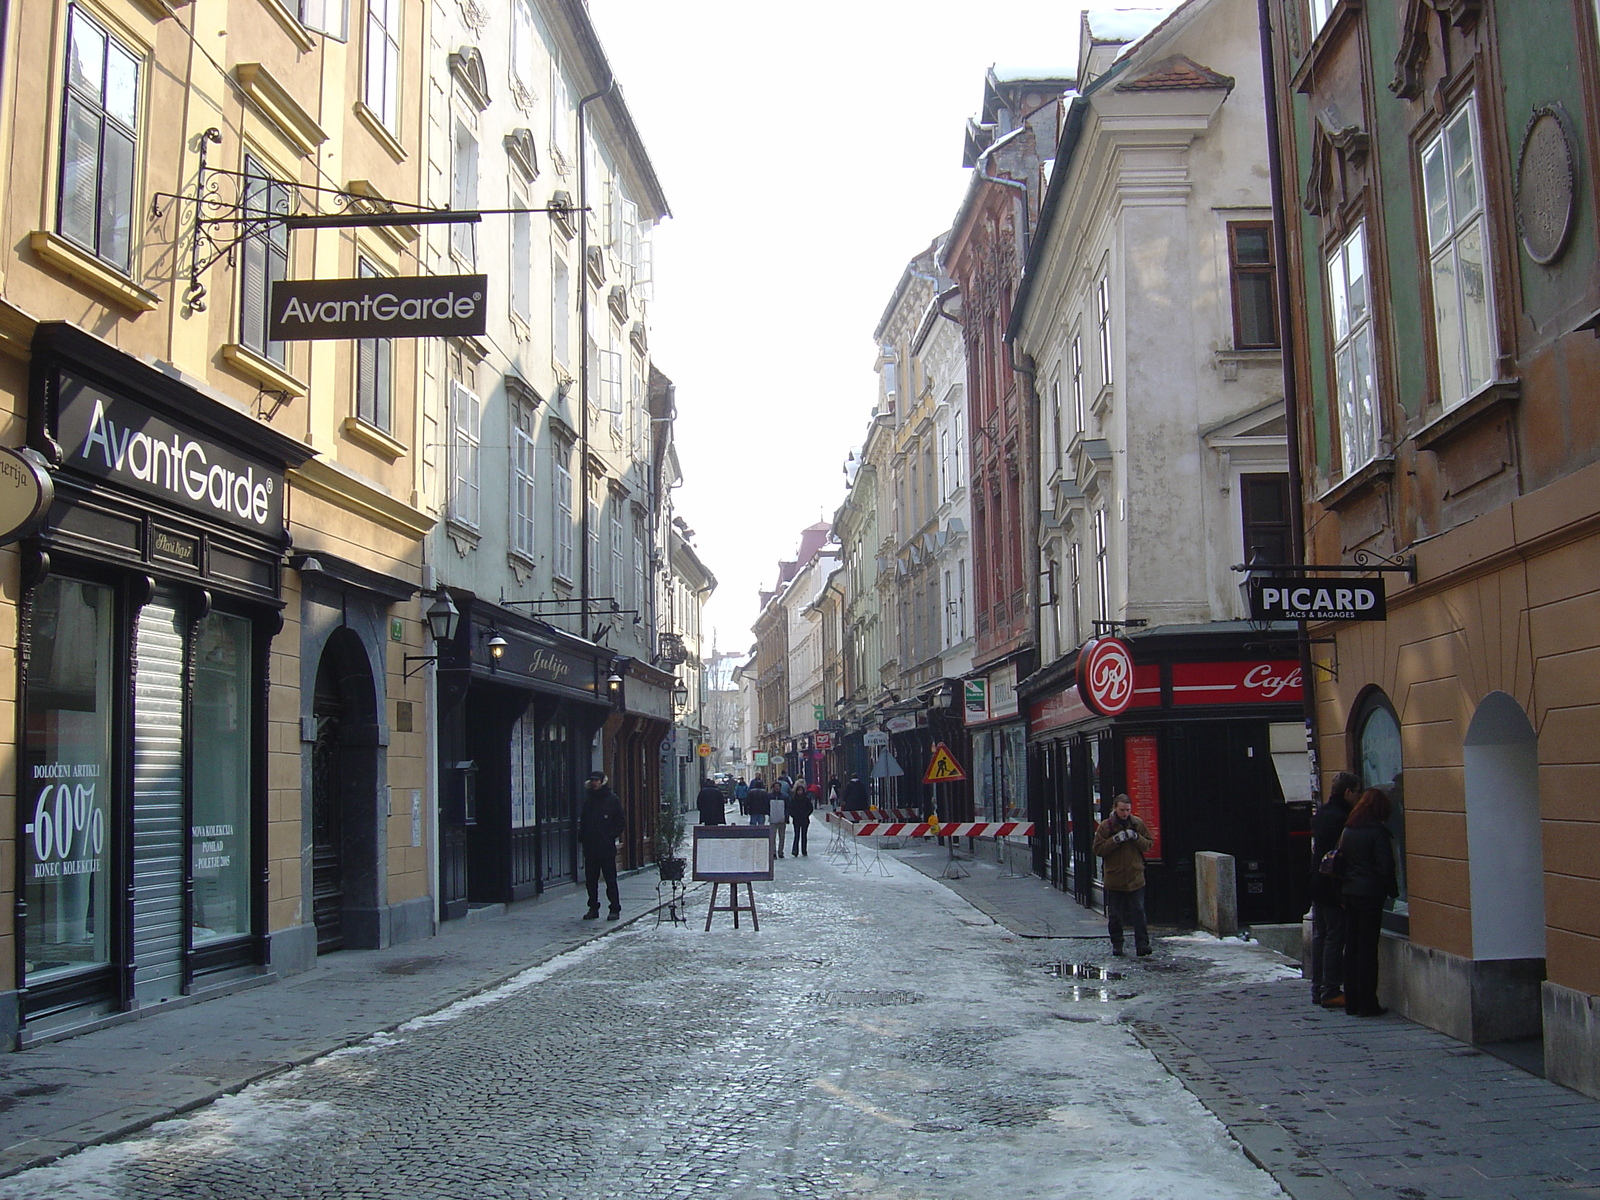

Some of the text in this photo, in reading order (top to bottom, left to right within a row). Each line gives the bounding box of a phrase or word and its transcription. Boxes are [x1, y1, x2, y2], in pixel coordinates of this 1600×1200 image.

[1262, 588, 1375, 611] PICARD
[529, 649, 570, 680] Julija
[34, 762, 100, 778] DOLOČENI ARTIKLI
[34, 859, 101, 878] KONEC KOLEKCIJE
